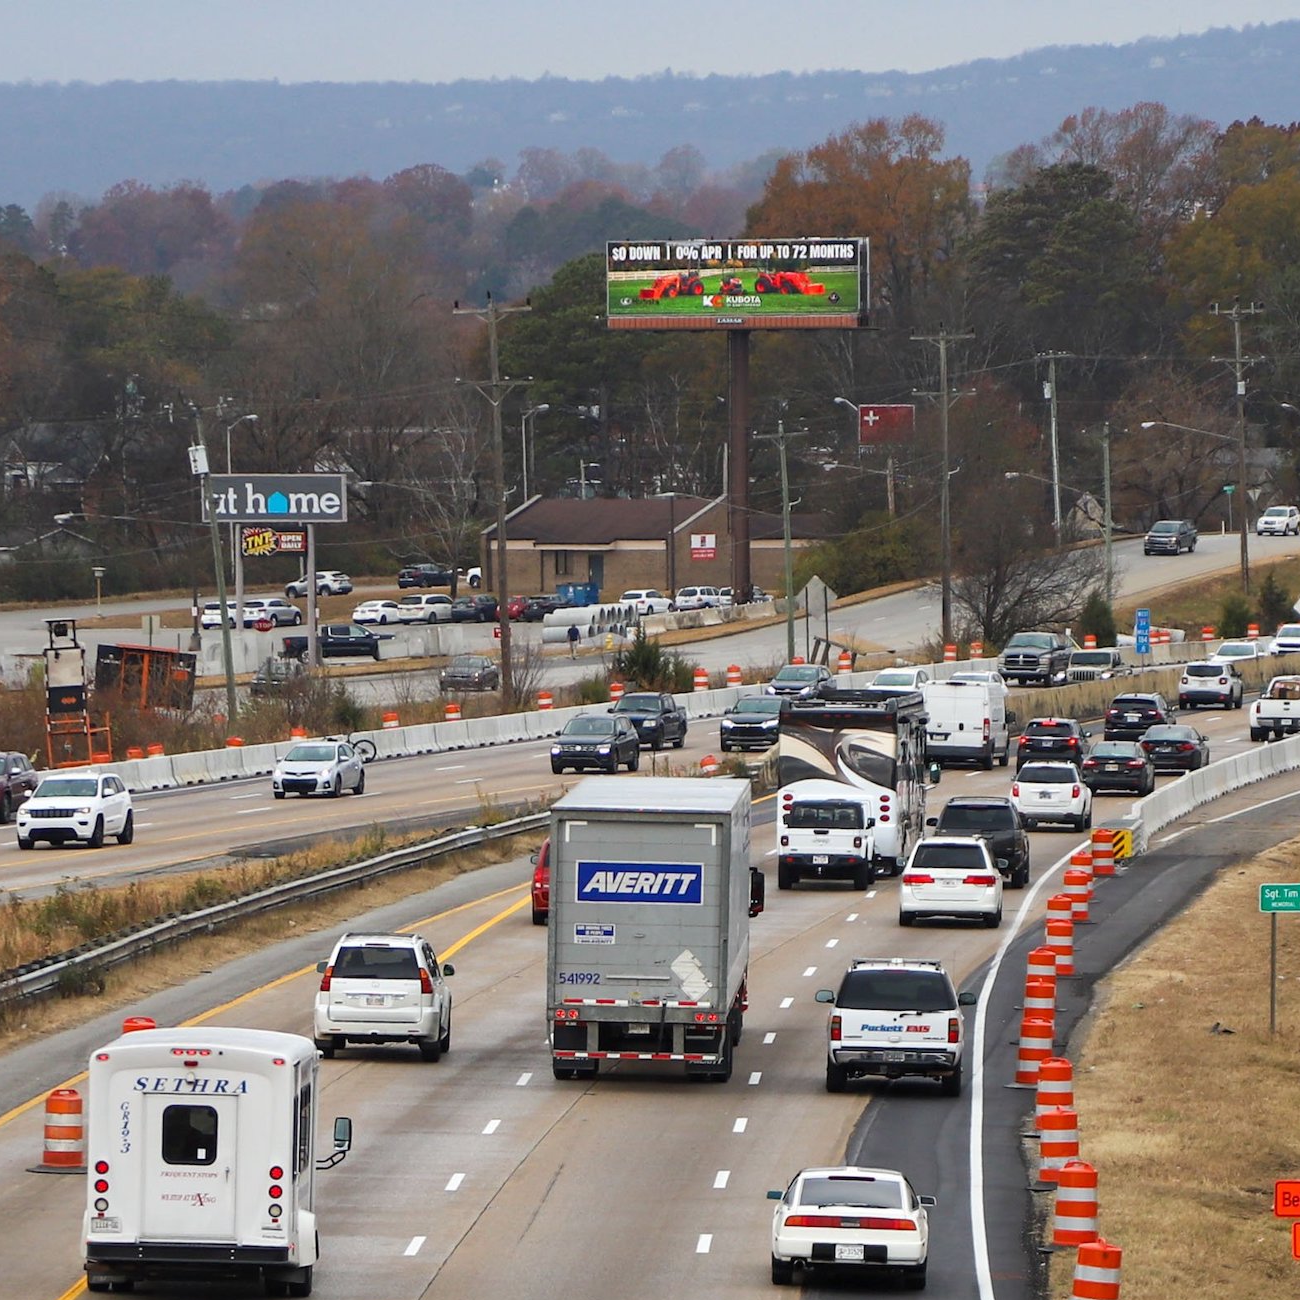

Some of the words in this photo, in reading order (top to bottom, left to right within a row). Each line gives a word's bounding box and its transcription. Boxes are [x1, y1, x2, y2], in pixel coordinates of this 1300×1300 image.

[629, 246, 660, 260] DOWN
[676, 246, 698, 260] 0%
[701, 245, 722, 259] APR
[737, 245, 757, 259] FOR
[760, 245, 775, 258] UP
[777, 245, 789, 259] TO
[792, 245, 807, 258] 72
[809, 244, 854, 258] MONTHS
[726, 295, 761, 303] KUBOTA
[246, 531, 273, 549] TNT
[582, 871, 697, 895] AVERITT
[1264, 889, 1281, 900] Sgt.
[1284, 889, 1298, 897] Tim
[558, 972, 600, 985] 541992
[134, 1077, 247, 1094] SETHRA
